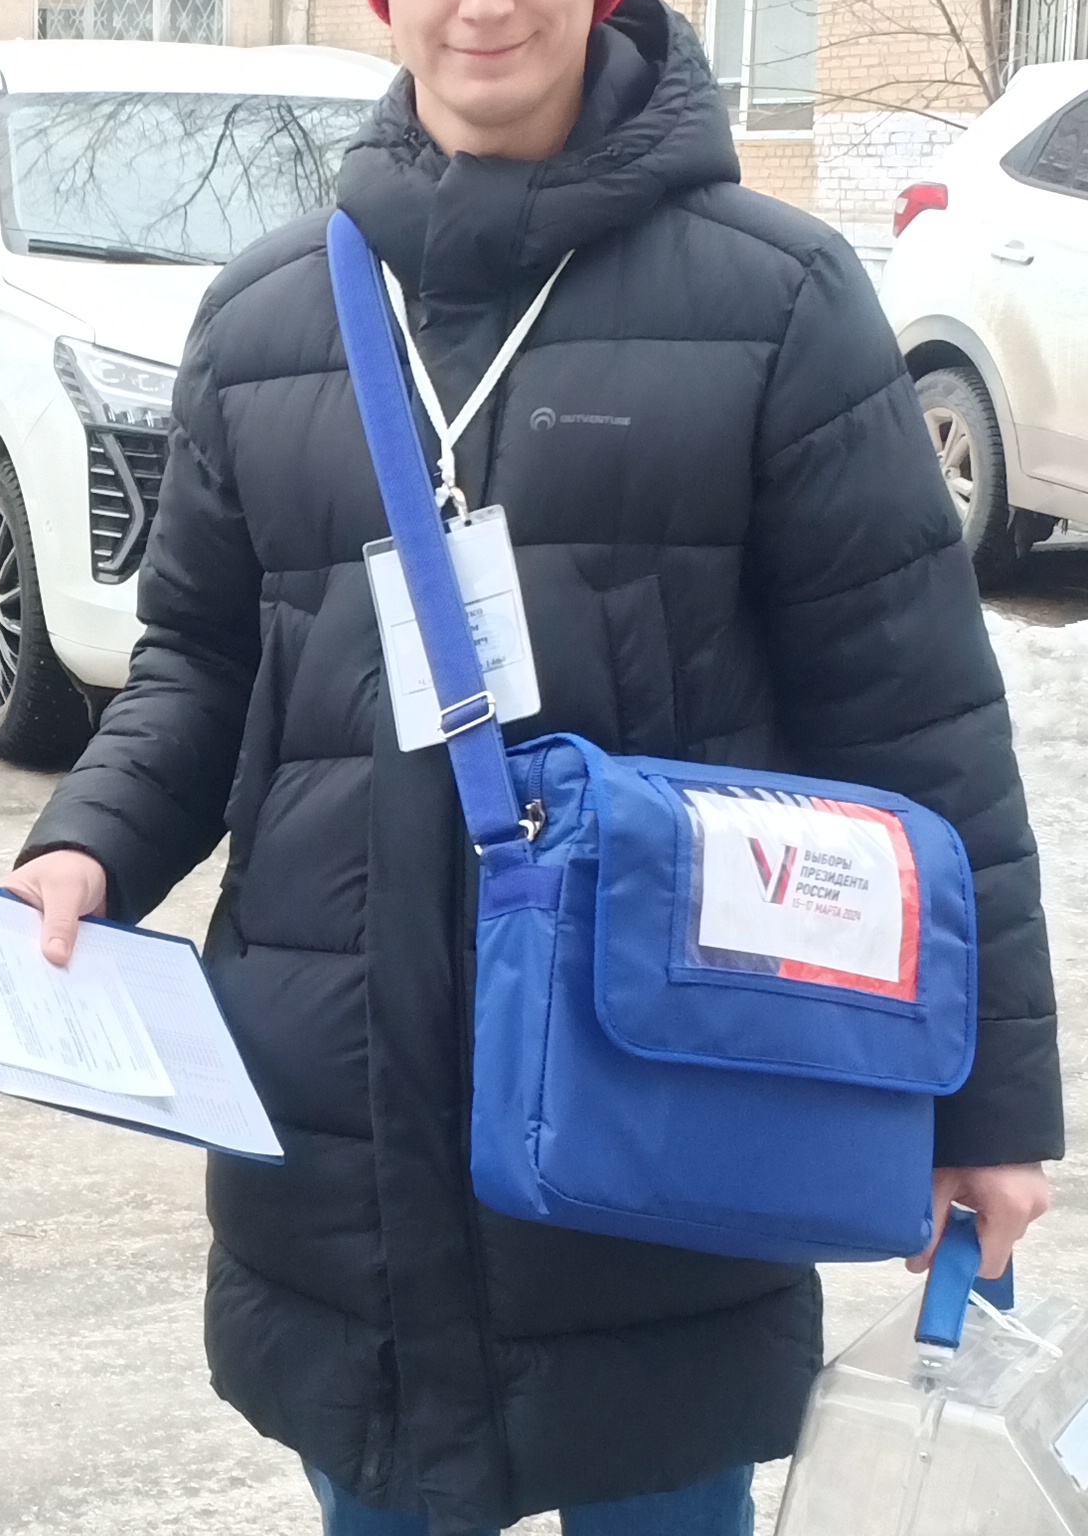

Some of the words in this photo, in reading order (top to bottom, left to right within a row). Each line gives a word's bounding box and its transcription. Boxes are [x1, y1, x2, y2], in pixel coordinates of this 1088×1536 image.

[804, 849, 853, 870] ВЫБОРЫ
[800, 865, 869, 891] ПРЕЗИДЕНТА
[795, 881, 841, 902] РОССИИ
[814, 902, 842, 918] МАРТА
[841, 908, 862, 922] 2024
